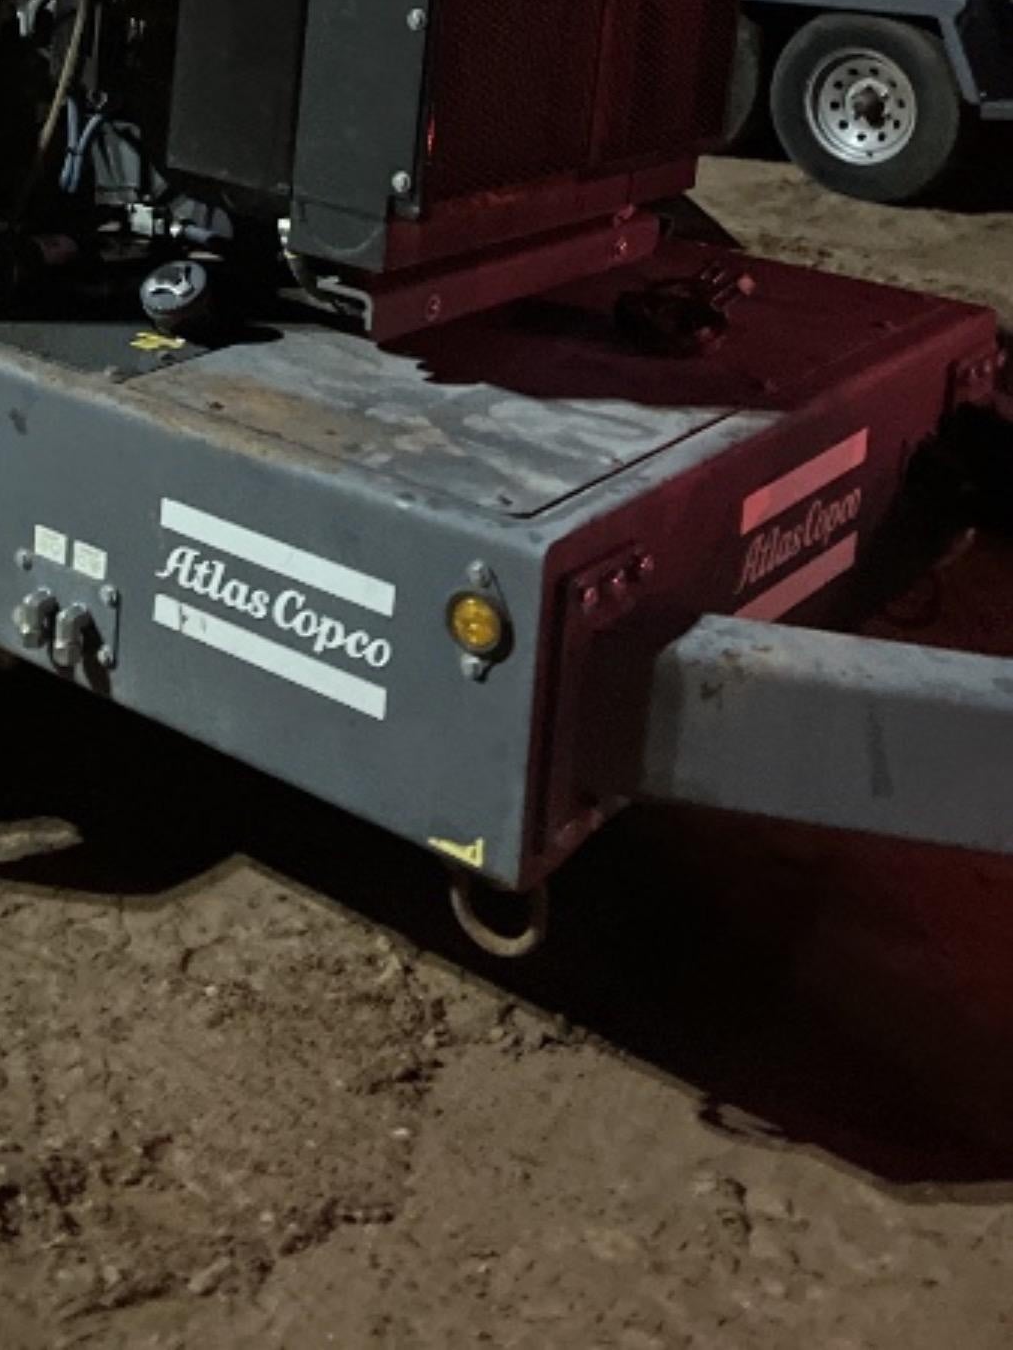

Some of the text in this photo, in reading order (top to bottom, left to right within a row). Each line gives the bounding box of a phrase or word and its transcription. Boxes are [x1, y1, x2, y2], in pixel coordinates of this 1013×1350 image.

[155, 545, 270, 619] Atlas
[272, 589, 391, 668] Copco
[732, 523, 802, 596] Atlas
